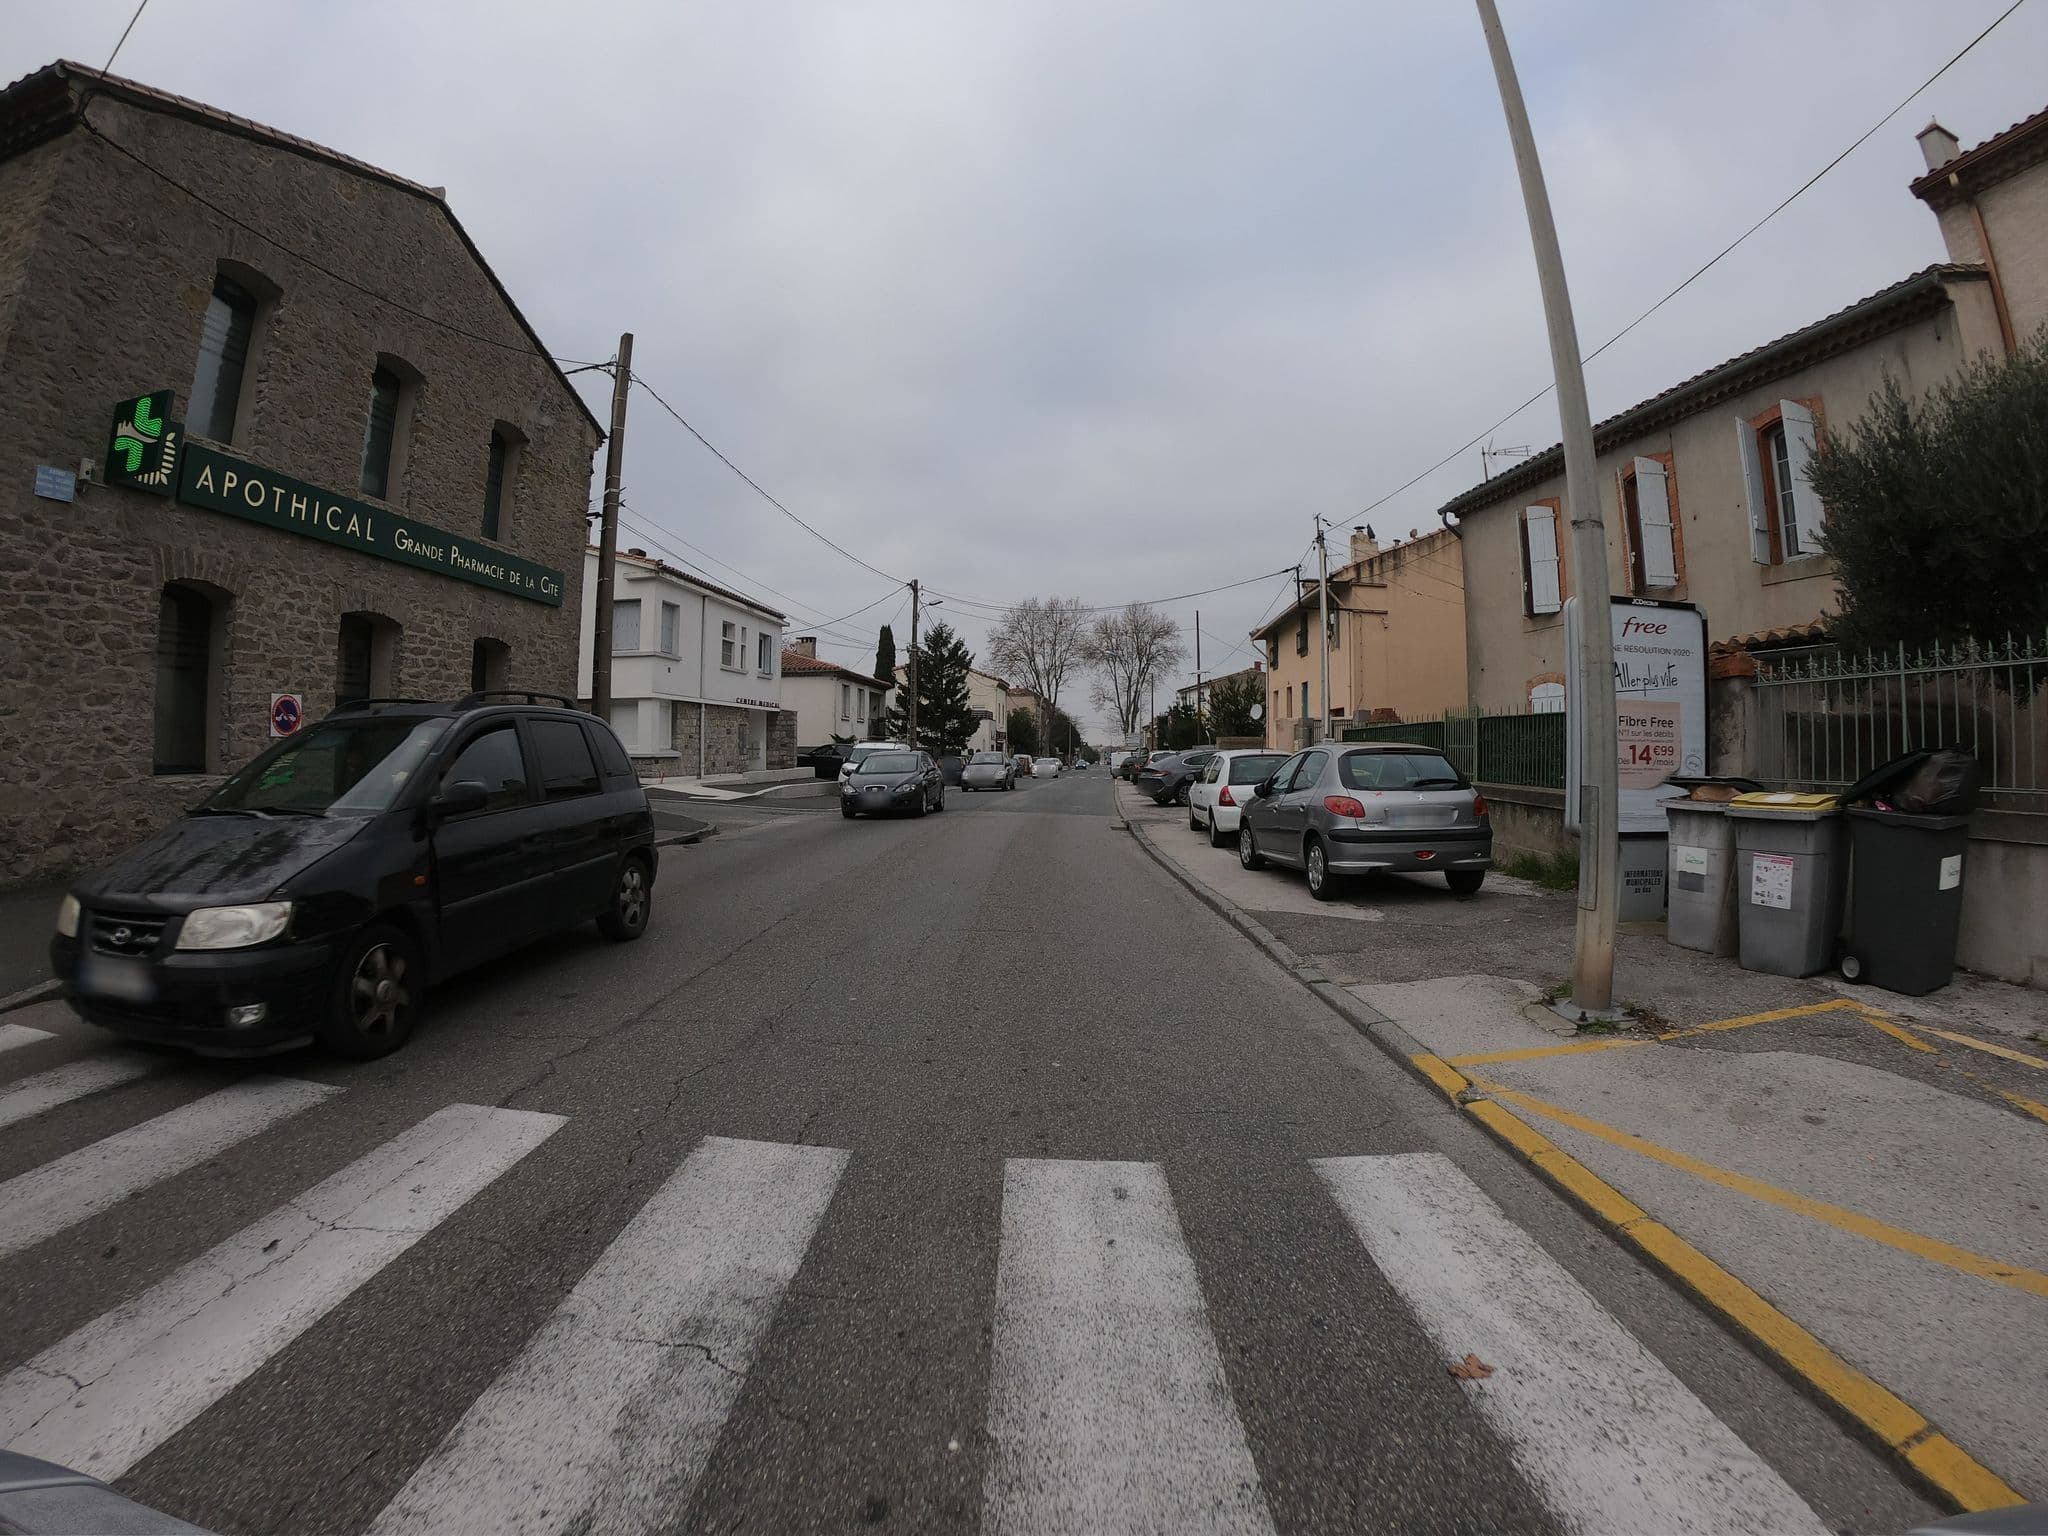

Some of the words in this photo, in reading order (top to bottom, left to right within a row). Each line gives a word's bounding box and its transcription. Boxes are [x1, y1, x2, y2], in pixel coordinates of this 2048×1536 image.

[195, 464, 375, 542] APOTHICAL
[1622, 616, 1667, 637] free
[1618, 715, 1647, 727] Fibre
[1650, 716, 1674, 728] Free
[1629, 744, 1652, 765] 14
[1653, 745, 1674, 756] €99
